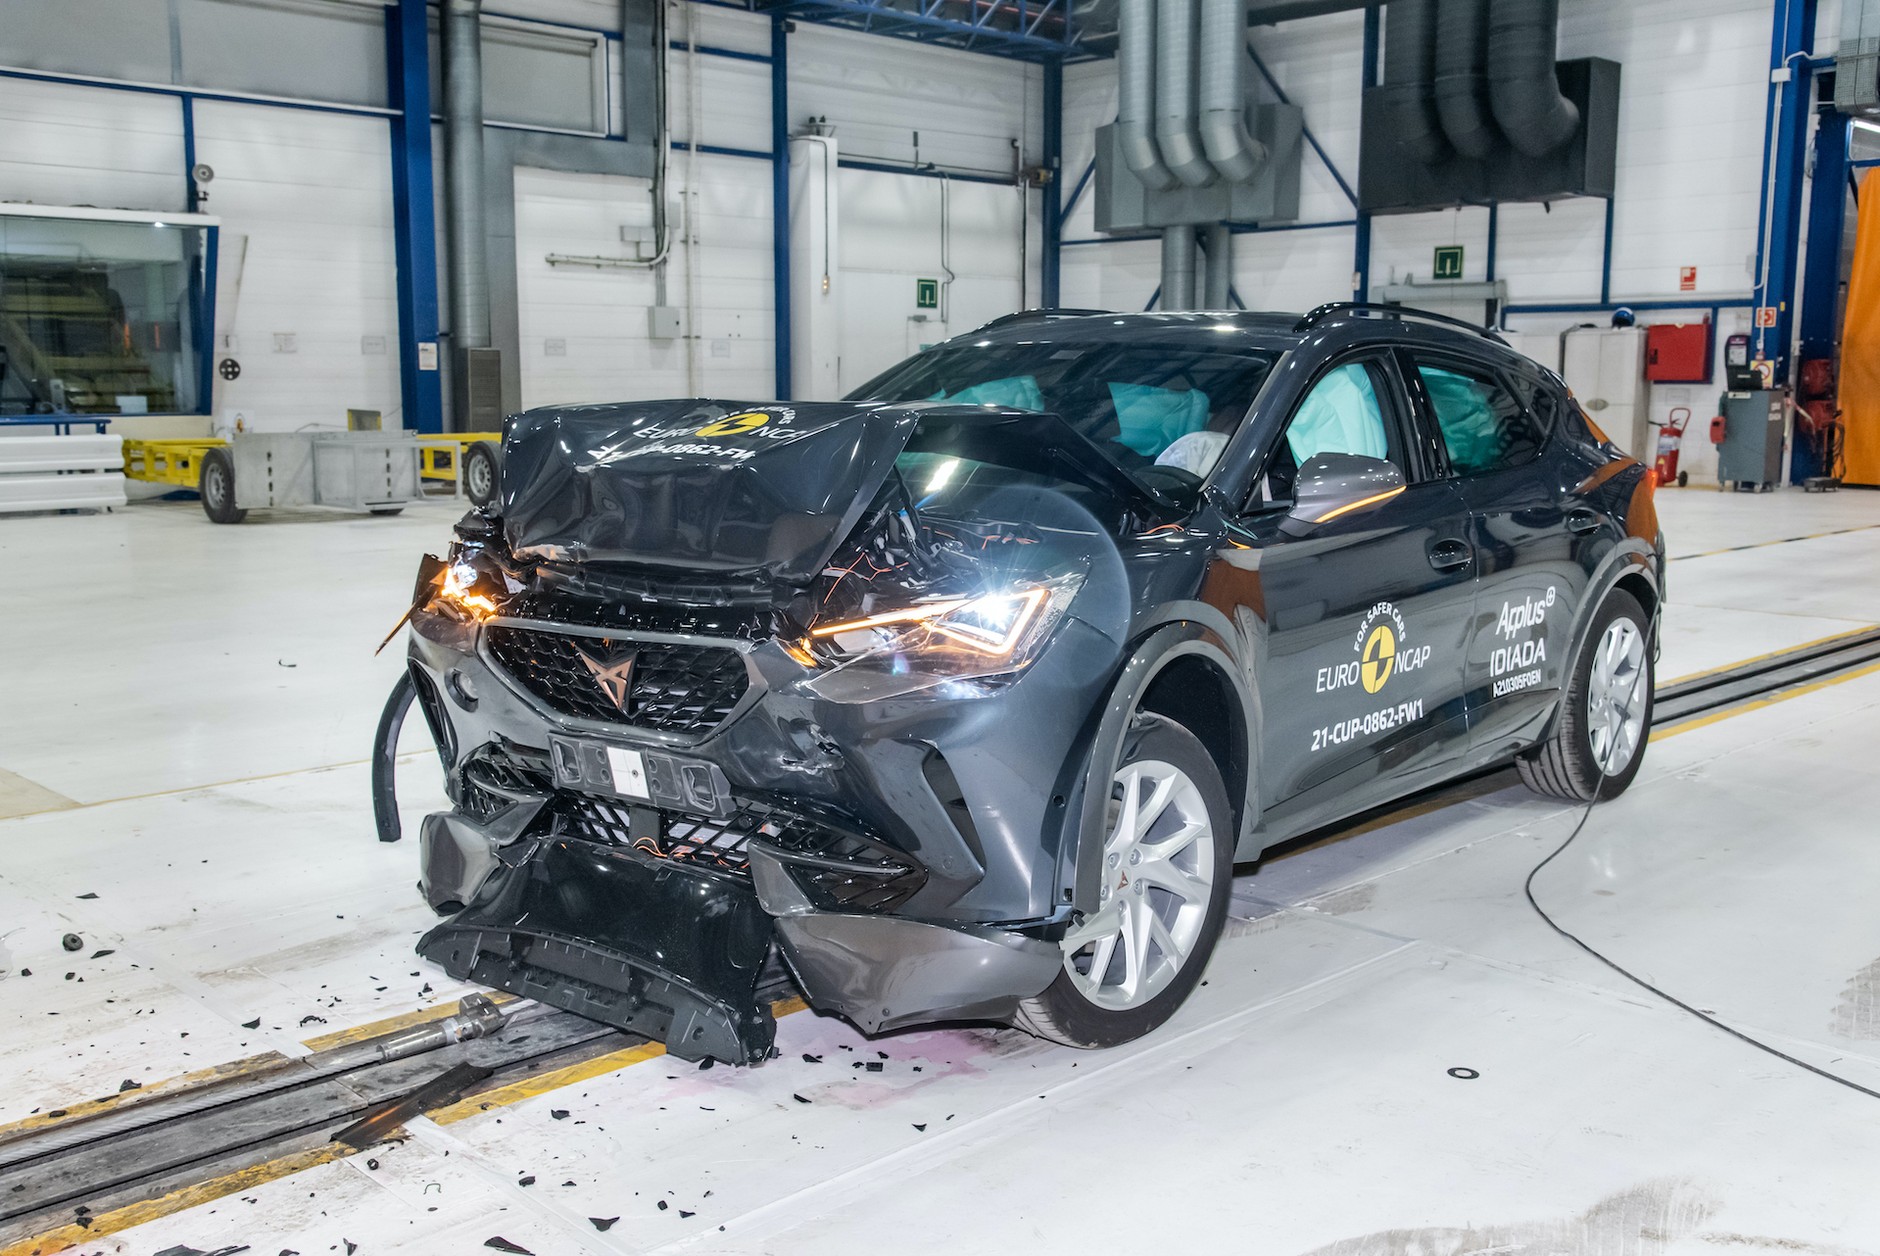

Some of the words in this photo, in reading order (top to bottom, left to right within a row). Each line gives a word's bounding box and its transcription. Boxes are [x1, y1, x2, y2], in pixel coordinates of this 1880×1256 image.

[1353, 620, 1368, 652] FOR
[1367, 602, 1392, 623] SAFER
[1392, 608, 1406, 642] CARS
[1316, 661, 1359, 693] EURO
[1393, 645, 1431, 675] NCAP
[1490, 637, 1546, 677] IDIADA
[1311, 698, 1423, 751] 21-CUP-0862-FW1
